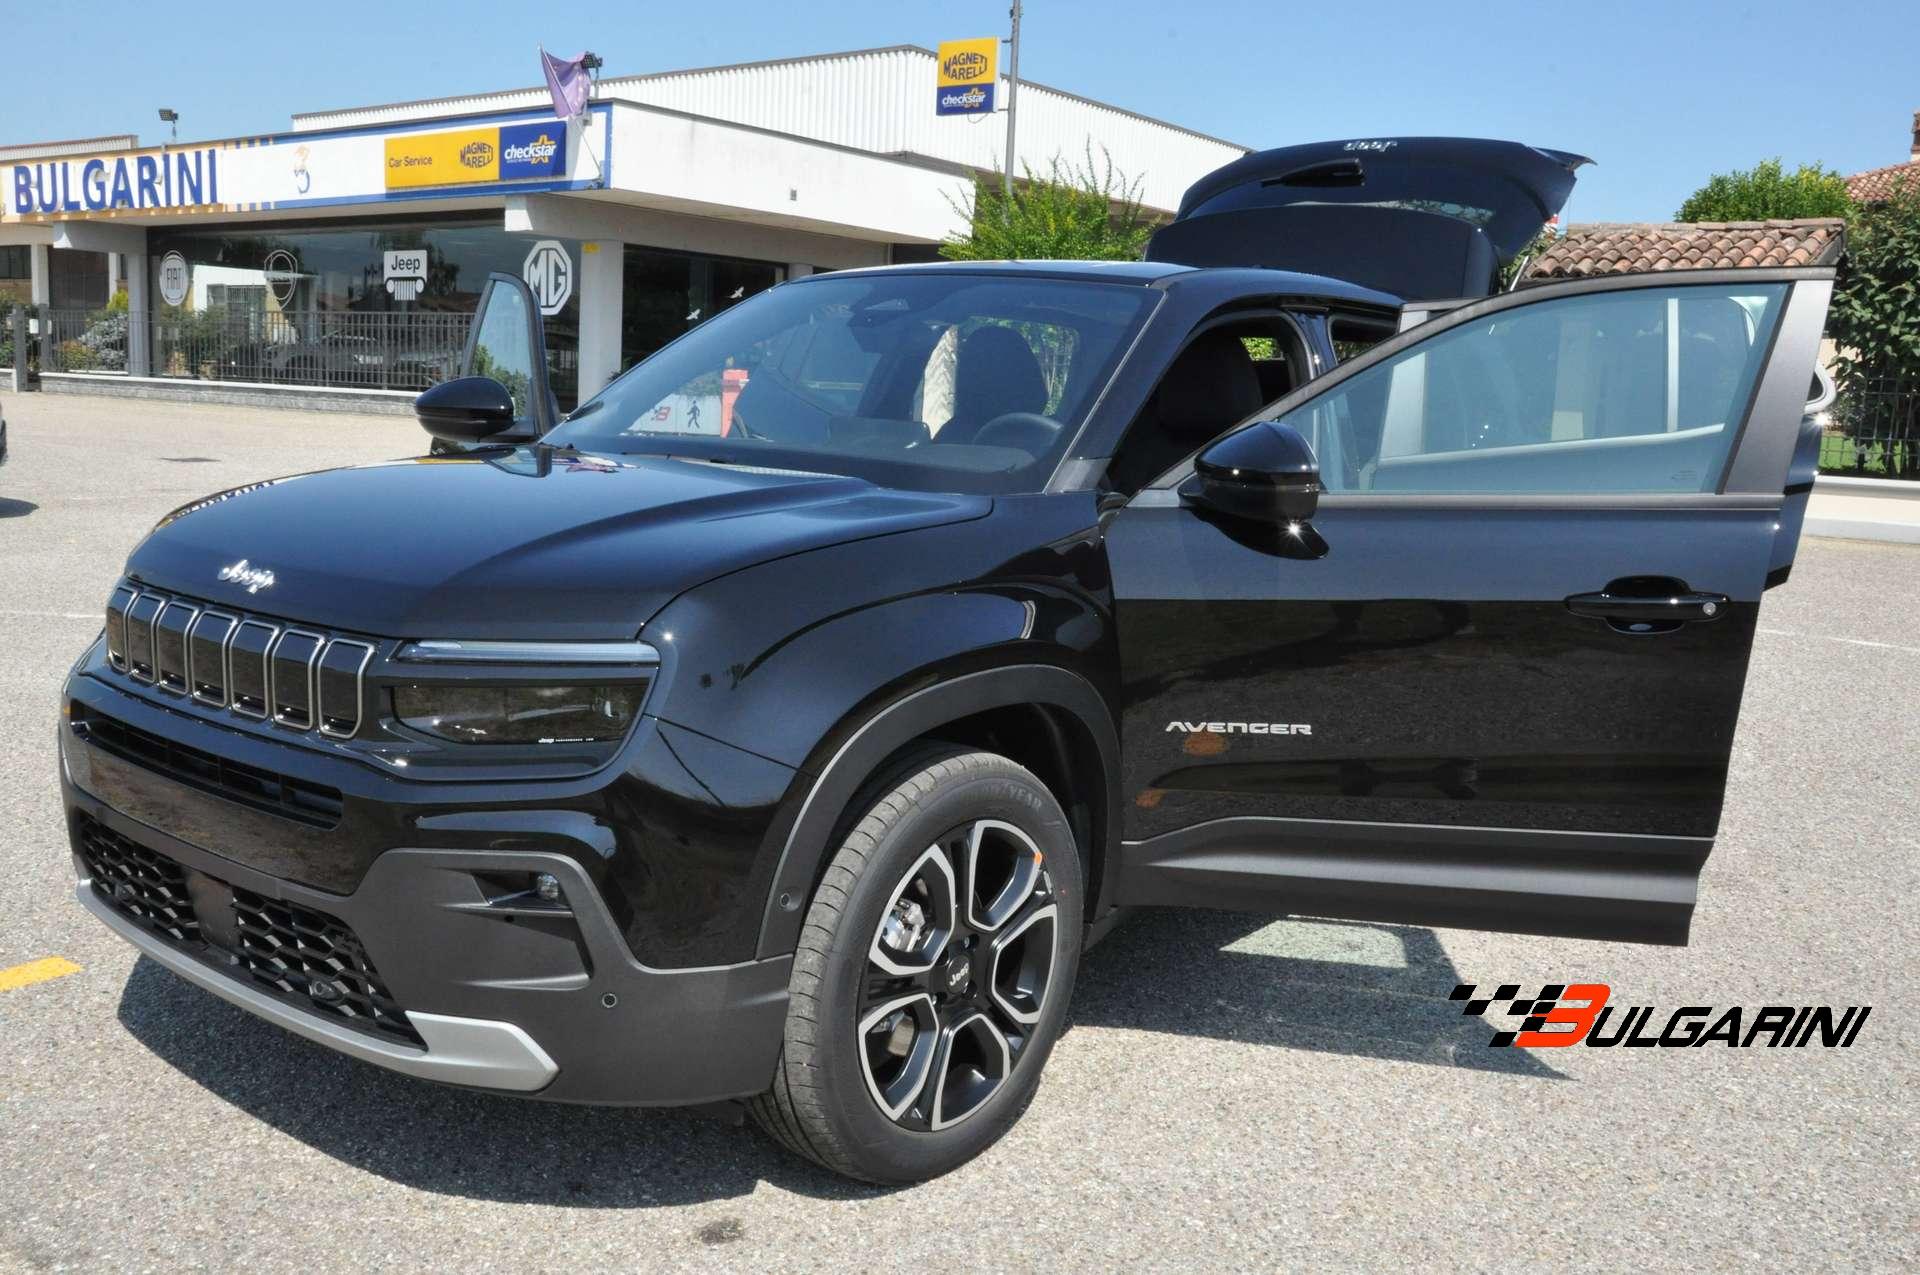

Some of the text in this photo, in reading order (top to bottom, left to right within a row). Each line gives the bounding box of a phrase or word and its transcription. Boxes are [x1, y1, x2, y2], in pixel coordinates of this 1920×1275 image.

[942, 94, 986, 105] checkstar
[504, 143, 557, 160] checkstar
[388, 154, 432, 168] Car Service
[14, 149, 218, 213] BULGARINI
[391, 255, 420, 273] Jeep
[529, 248, 568, 307] MG
[1165, 721, 1312, 735] AVENGER
